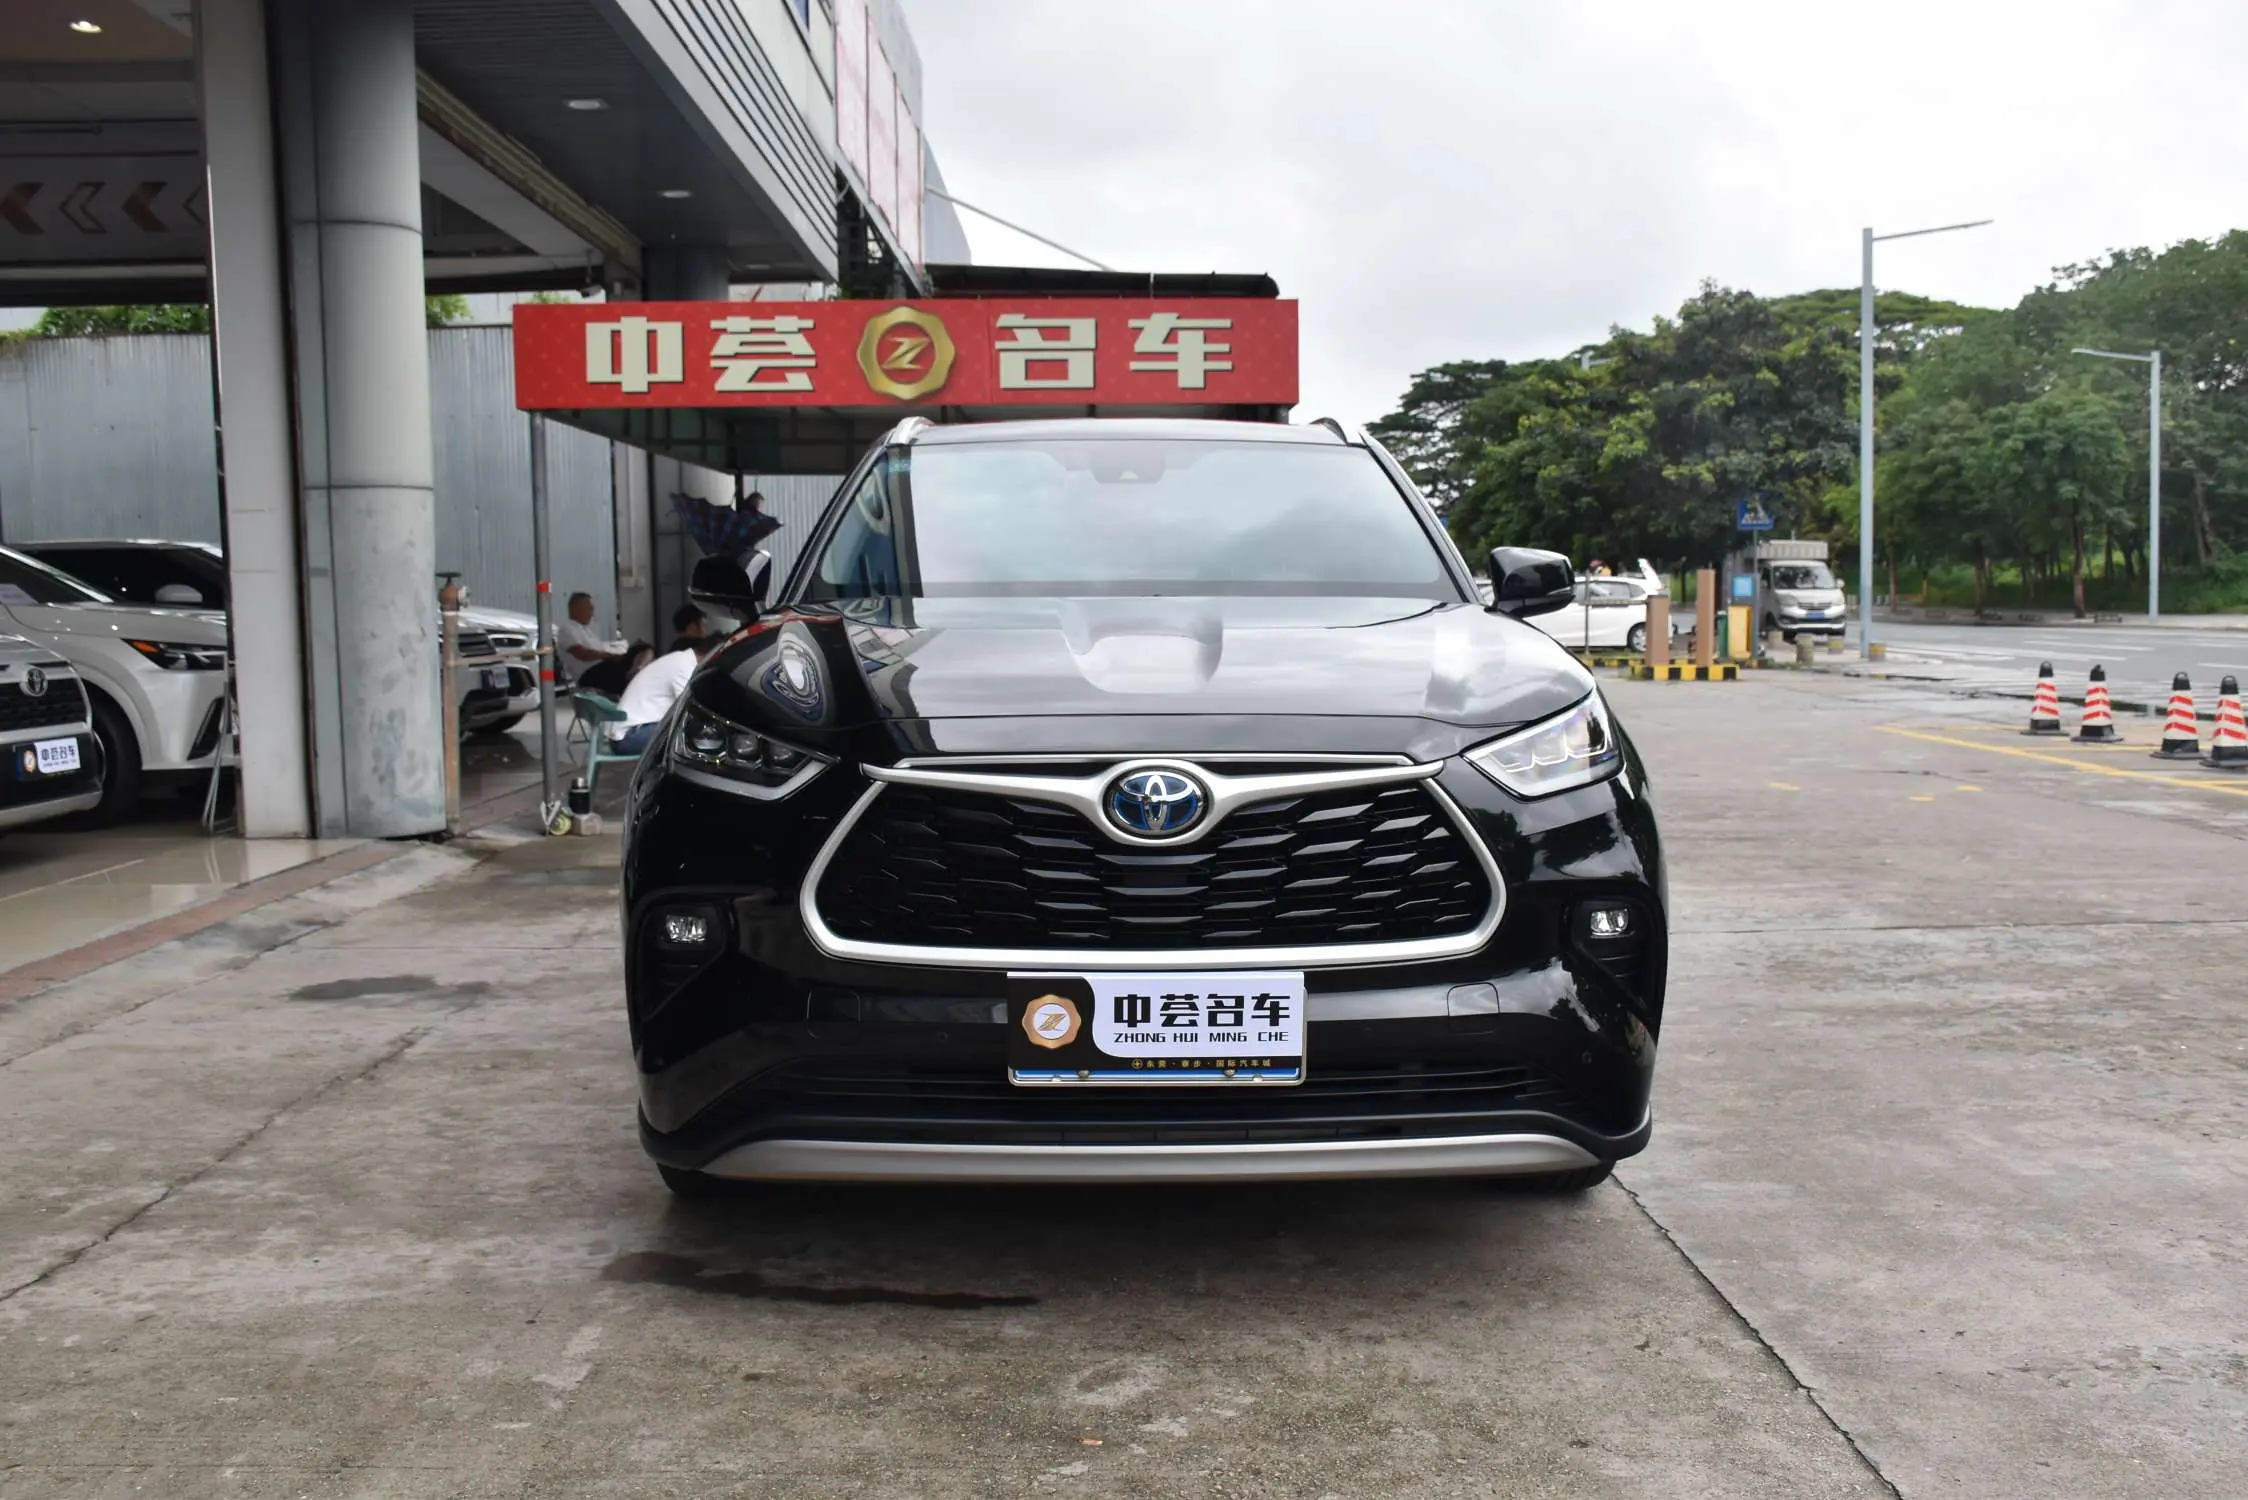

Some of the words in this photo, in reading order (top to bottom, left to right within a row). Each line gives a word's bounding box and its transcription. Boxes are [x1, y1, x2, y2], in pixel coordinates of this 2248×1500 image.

[585, 316, 815, 393] 中荟
[995, 312, 1233, 390] 名车
[1113, 993, 1291, 1028] 中荟名车
[1114, 1032, 1166, 1043] ZHONG
[1173, 1032, 1199, 1043] HUI
[1209, 1032, 1248, 1043] MING
[1257, 1031, 1289, 1042] CHE
